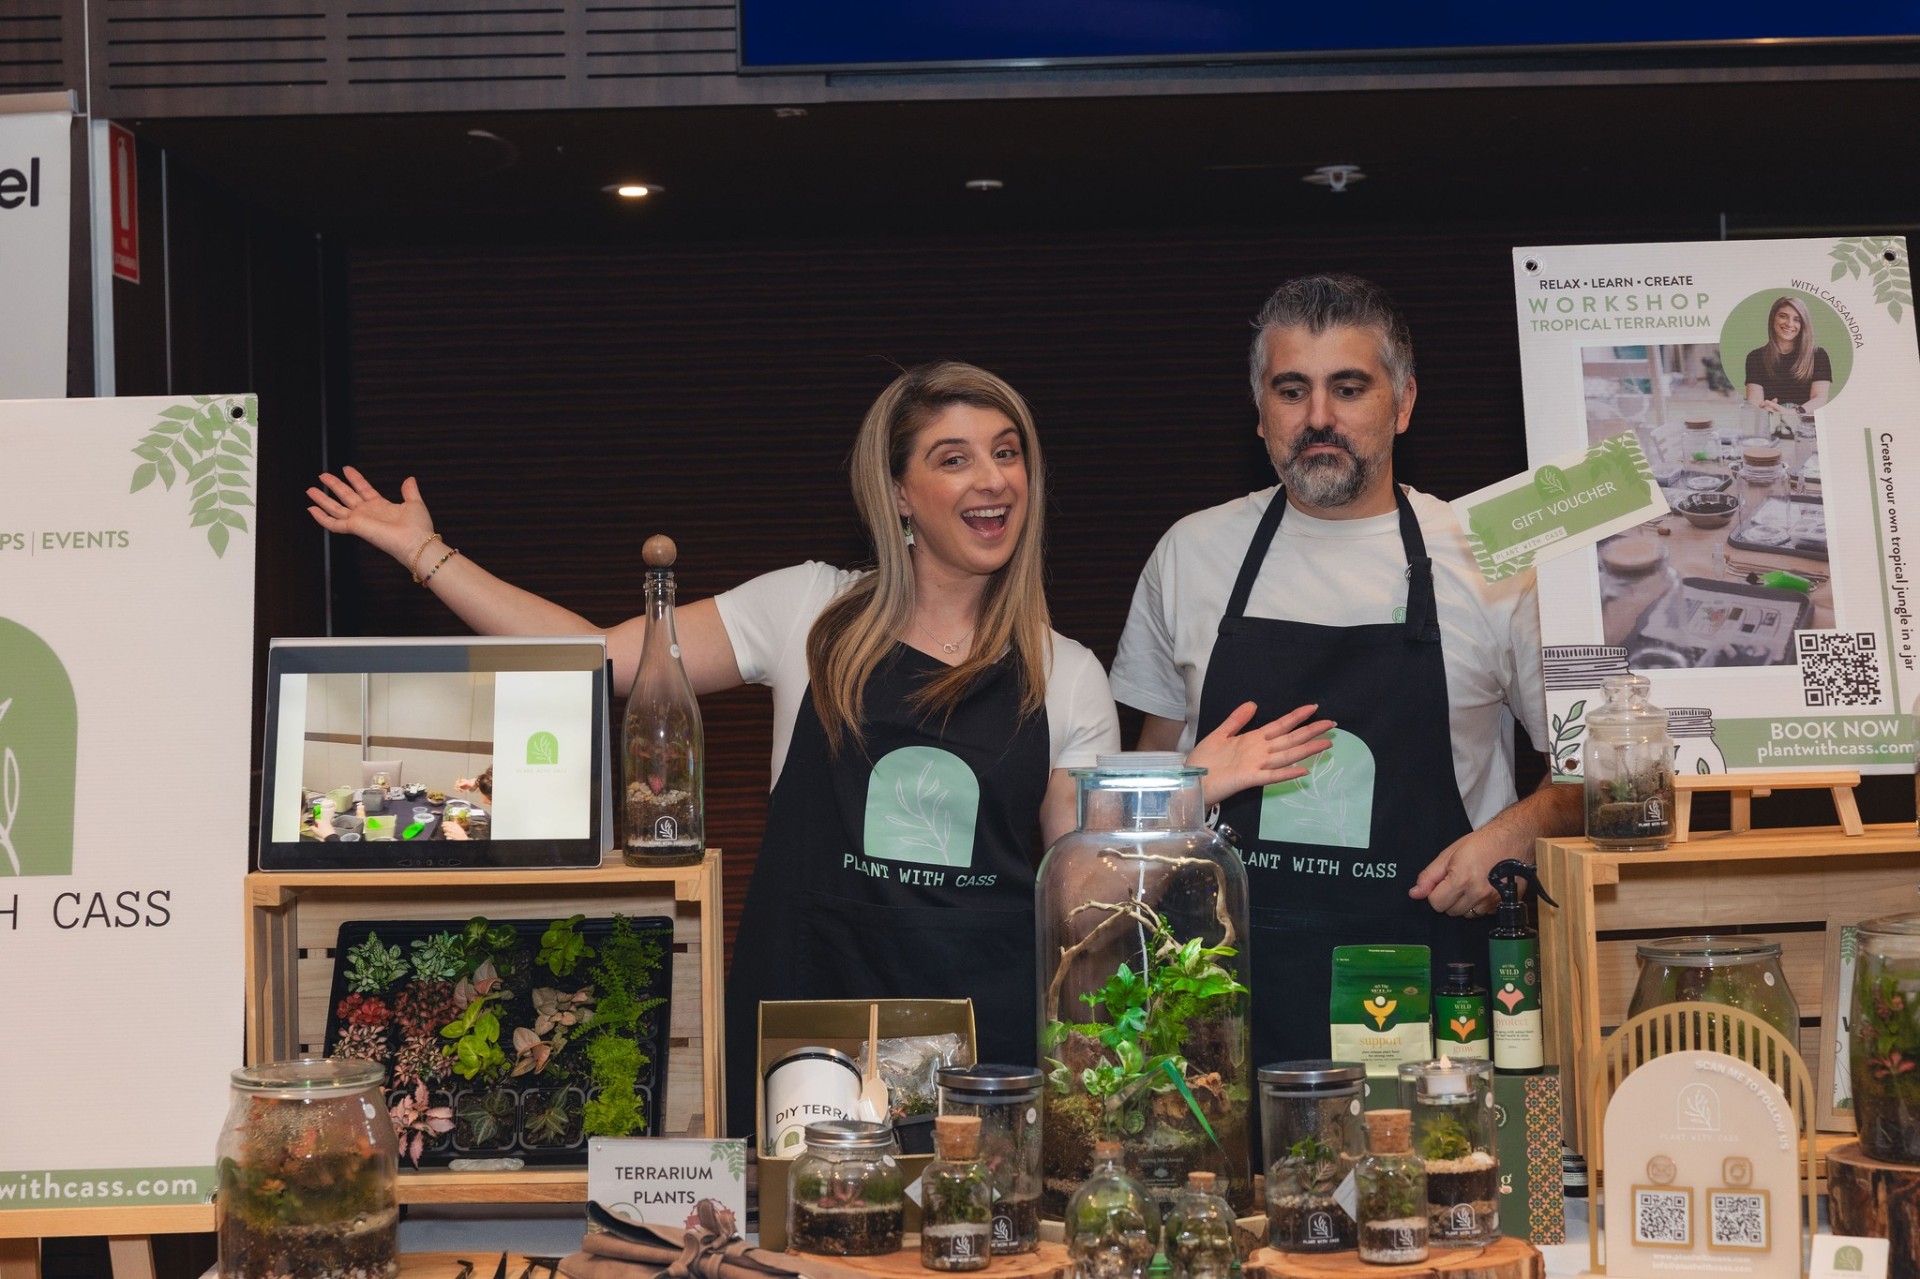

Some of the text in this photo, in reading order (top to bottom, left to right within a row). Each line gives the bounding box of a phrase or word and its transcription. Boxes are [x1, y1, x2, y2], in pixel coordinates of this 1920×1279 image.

[1539, 275, 1694, 290] RELAX LEARN CREATE
[1528, 292, 1710, 314] WORKSHOP
[1791, 278, 1864, 349] WITH CASSANDRA
[1530, 315, 1711, 332] TROPICAL TERRARIUM
[1880, 432, 1893, 474] Create
[1880, 477, 1895, 504] your
[1511, 481, 1618, 531] GIFT VOUCHER
[1888, 508, 1898, 533] own
[42, 530, 130, 550] EVENTS
[1495, 529, 1565, 560] PLANT WITH CASS
[1888, 536, 1908, 583] tropical
[1892, 585, 1912, 625] jungle
[1901, 629, 1914, 641] in
[1899, 653, 1917, 671] jar
[1770, 720, 1899, 740] BOOK NOW
[1757, 740, 1914, 764] plantwithcass.com
[843, 853, 997, 888] PLANT WITH CASS
[1236, 848, 1397, 879] LANT WITH CASS
[53, 890, 171, 930] CASS
[1500, 968, 1520, 976] WILD
[1496, 1018, 1528, 1029] protect
[1360, 1037, 1402, 1048] support
[1453, 1046, 1473, 1055] grow
[775, 1106, 799, 1124] DIY
[1695, 1060, 1790, 1151] SCAN ME TO FOLLOW US
[614, 1166, 713, 1180] TERRARIUM
[633, 1191, 696, 1204] PLANTS
